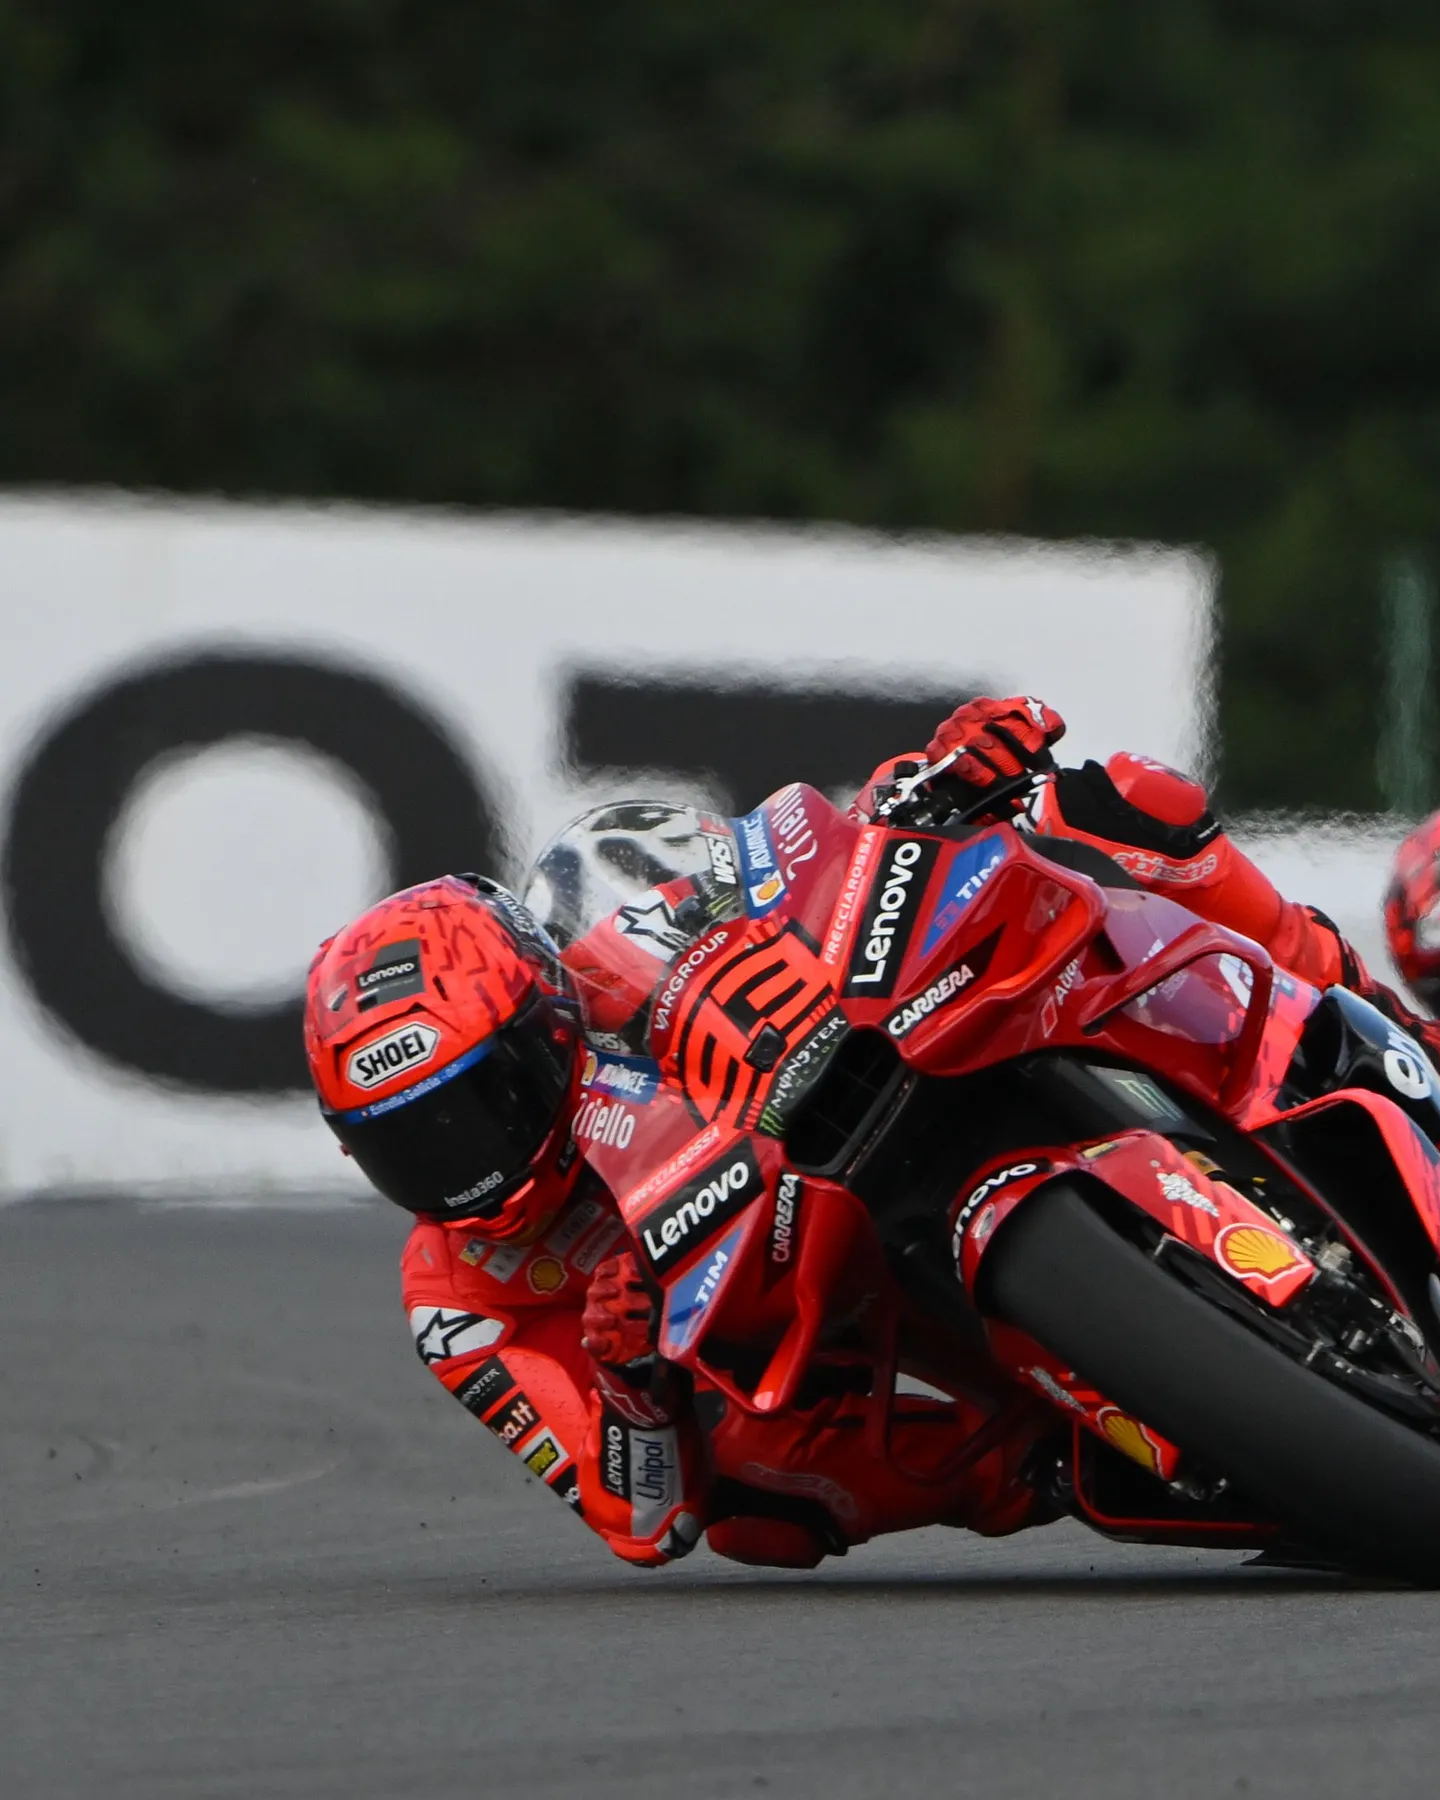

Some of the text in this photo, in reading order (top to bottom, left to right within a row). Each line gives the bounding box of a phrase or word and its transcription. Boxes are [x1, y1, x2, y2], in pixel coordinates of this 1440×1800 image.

[824, 830, 877, 966] FRECCIAROSSA
[851, 841, 922, 984] Lenovo
[955, 855, 1002, 900] TIM
[358, 962, 416, 988] Lenovo
[654, 930, 729, 1031] VARGROUP
[888, 963, 976, 1036] CARRERA
[355, 1030, 427, 1082] SHOEI
[680, 918, 838, 1131] 93
[770, 1016, 848, 1109] MONSTER
[643, 1161, 750, 1262] Lenovo
[772, 1173, 801, 1263] CARRERA
[694, 1250, 729, 1304] TIM
[606, 1424, 625, 1497] Lenovo
[634, 1437, 676, 1500] Unipol
